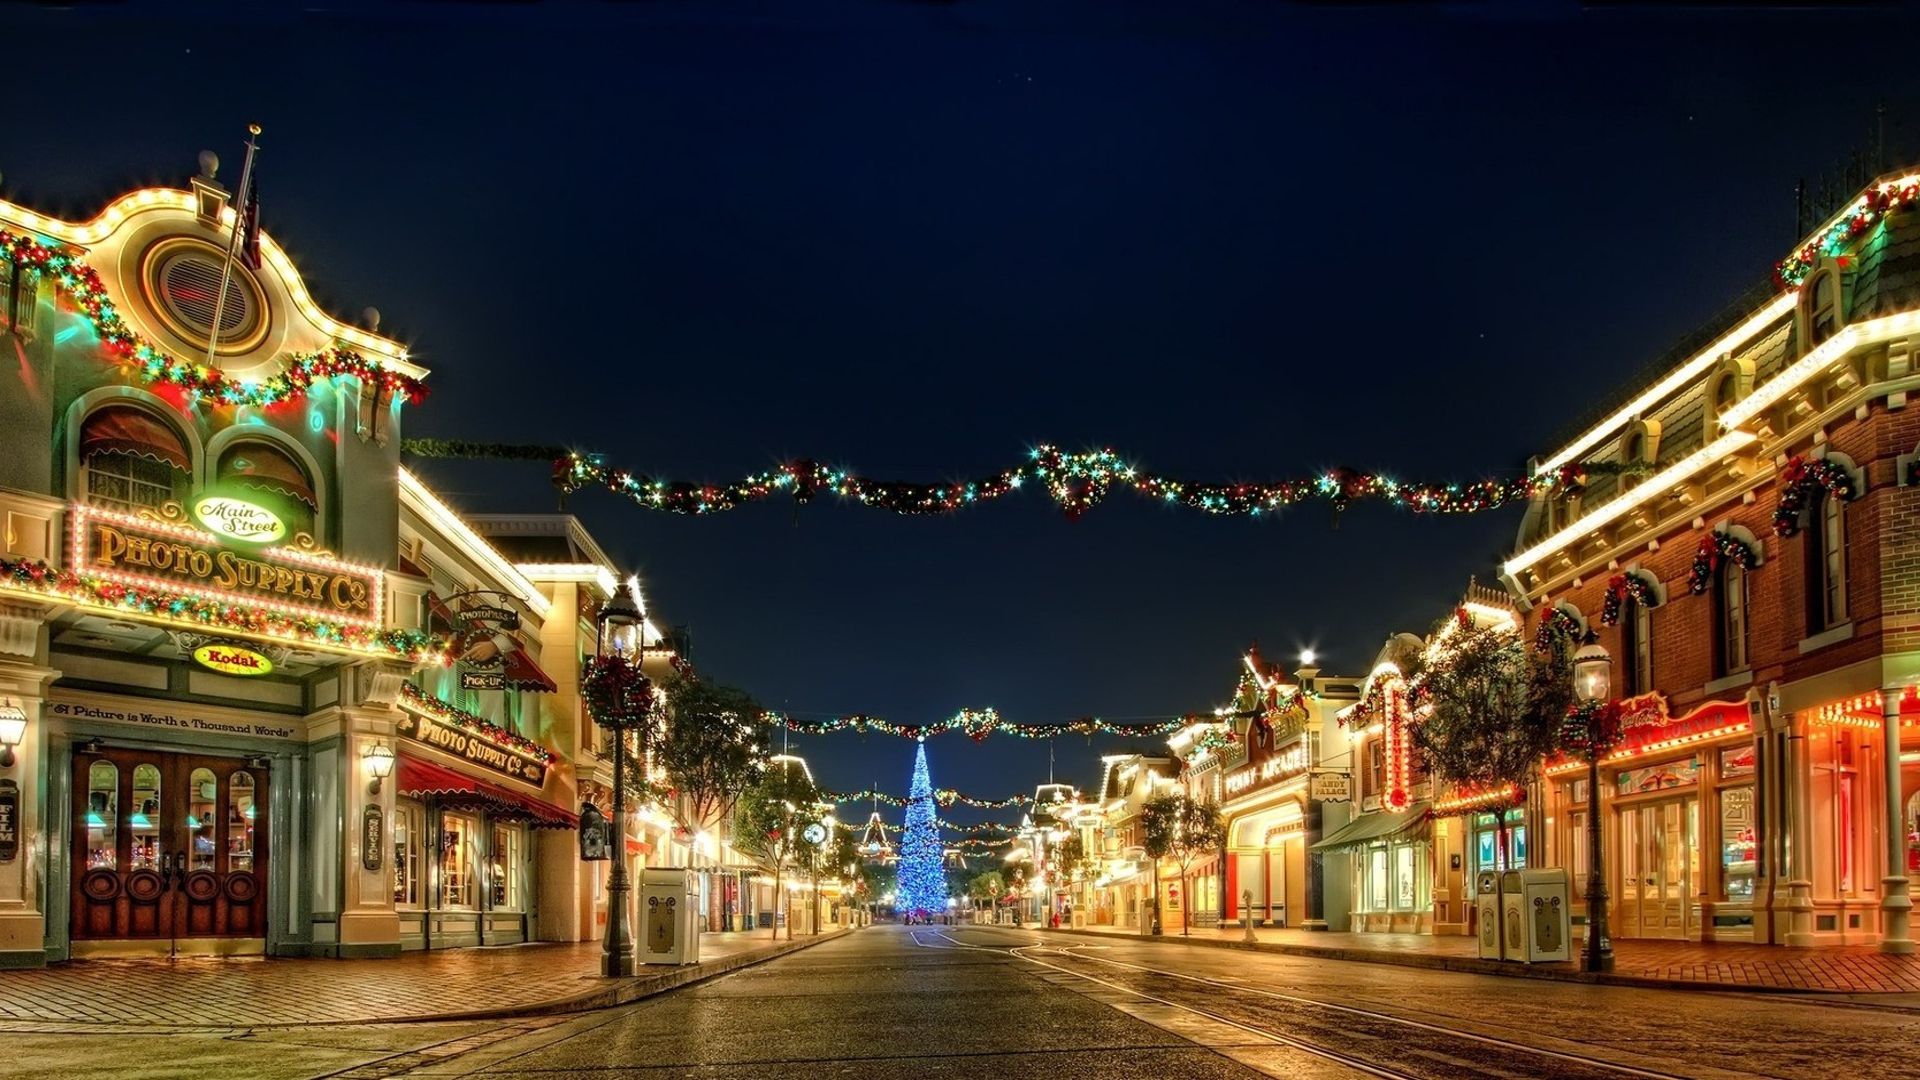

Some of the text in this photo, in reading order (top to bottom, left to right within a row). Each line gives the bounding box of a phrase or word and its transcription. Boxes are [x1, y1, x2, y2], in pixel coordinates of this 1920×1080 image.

[200, 502, 268, 520] Main
[223, 518, 278, 536] Street
[97, 525, 213, 577] PHOTO
[213, 551, 328, 600] SUPPLY
[208, 650, 259, 668] Kodak
[466, 675, 502, 686] PICK-UP
[74, 705, 124, 720] Picture
[127, 713, 138, 722] is
[140, 713, 178, 726] Worth
[191, 719, 251, 733] Thousand
[417, 717, 466, 751] PHOTO
[466, 738, 508, 767] SUPPLY
[0, 804, 14, 841] FILM
